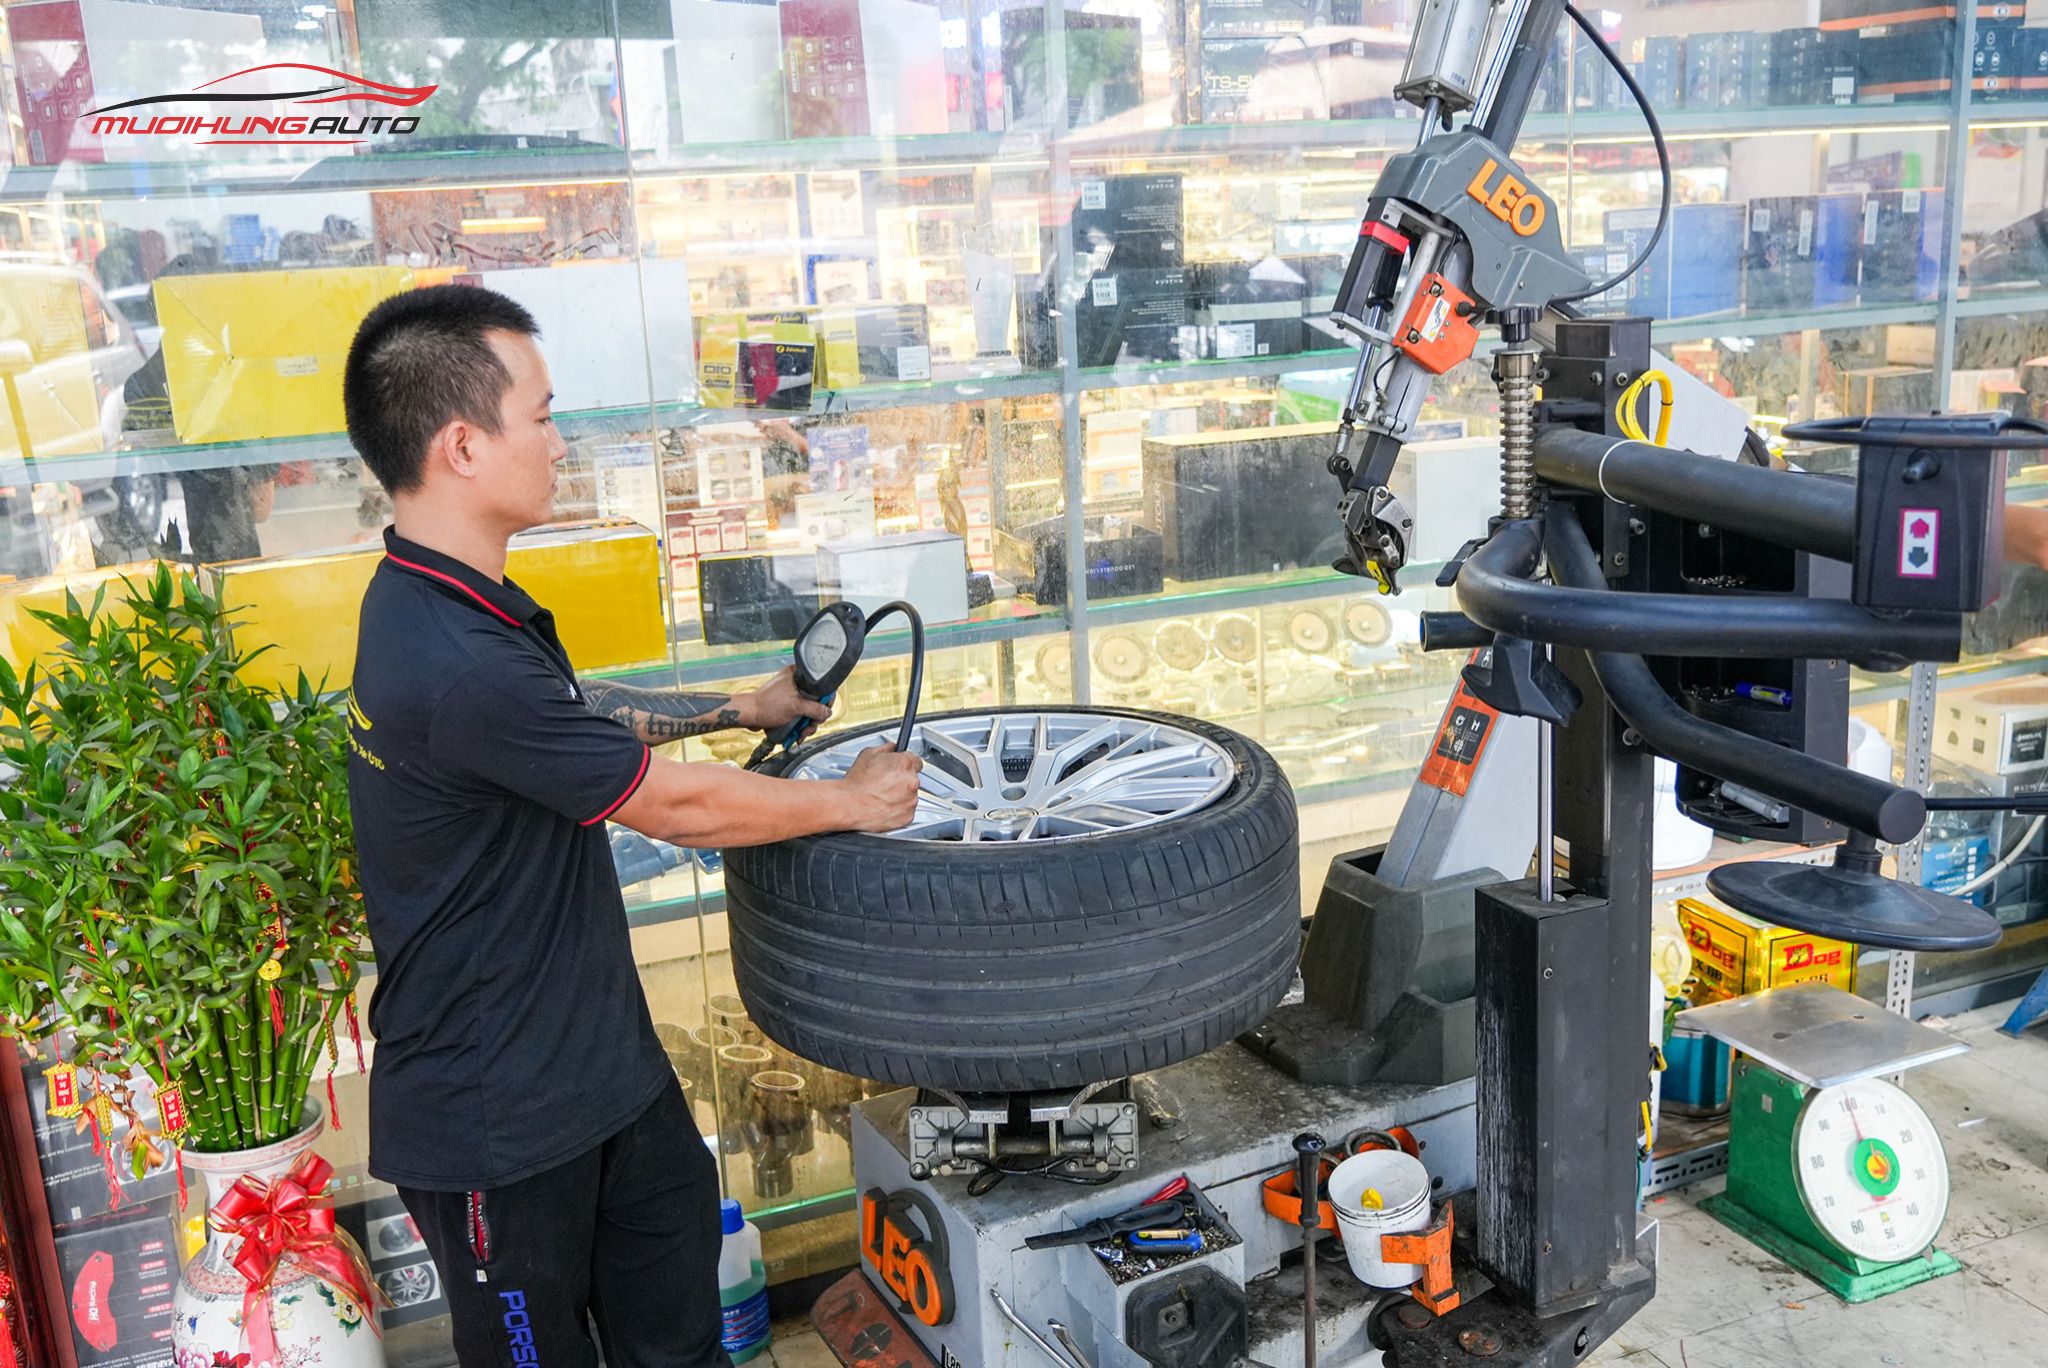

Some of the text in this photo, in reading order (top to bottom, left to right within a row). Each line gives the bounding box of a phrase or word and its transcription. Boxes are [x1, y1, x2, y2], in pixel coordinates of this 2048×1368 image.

[1466, 158, 1545, 237] LEO
[1688, 920, 1735, 970] Dog
[1783, 943, 1841, 972] Dog
[1818, 1119, 1830, 1131] 90
[1900, 1130, 1913, 1144] 20
[1811, 1154, 1824, 1169] 80
[1823, 1195, 1835, 1208] 70
[1906, 1202, 1919, 1216] 40
[1850, 1219, 1864, 1235] 60
[1884, 1227, 1896, 1240] 50
[861, 1193, 943, 1326] LEO
